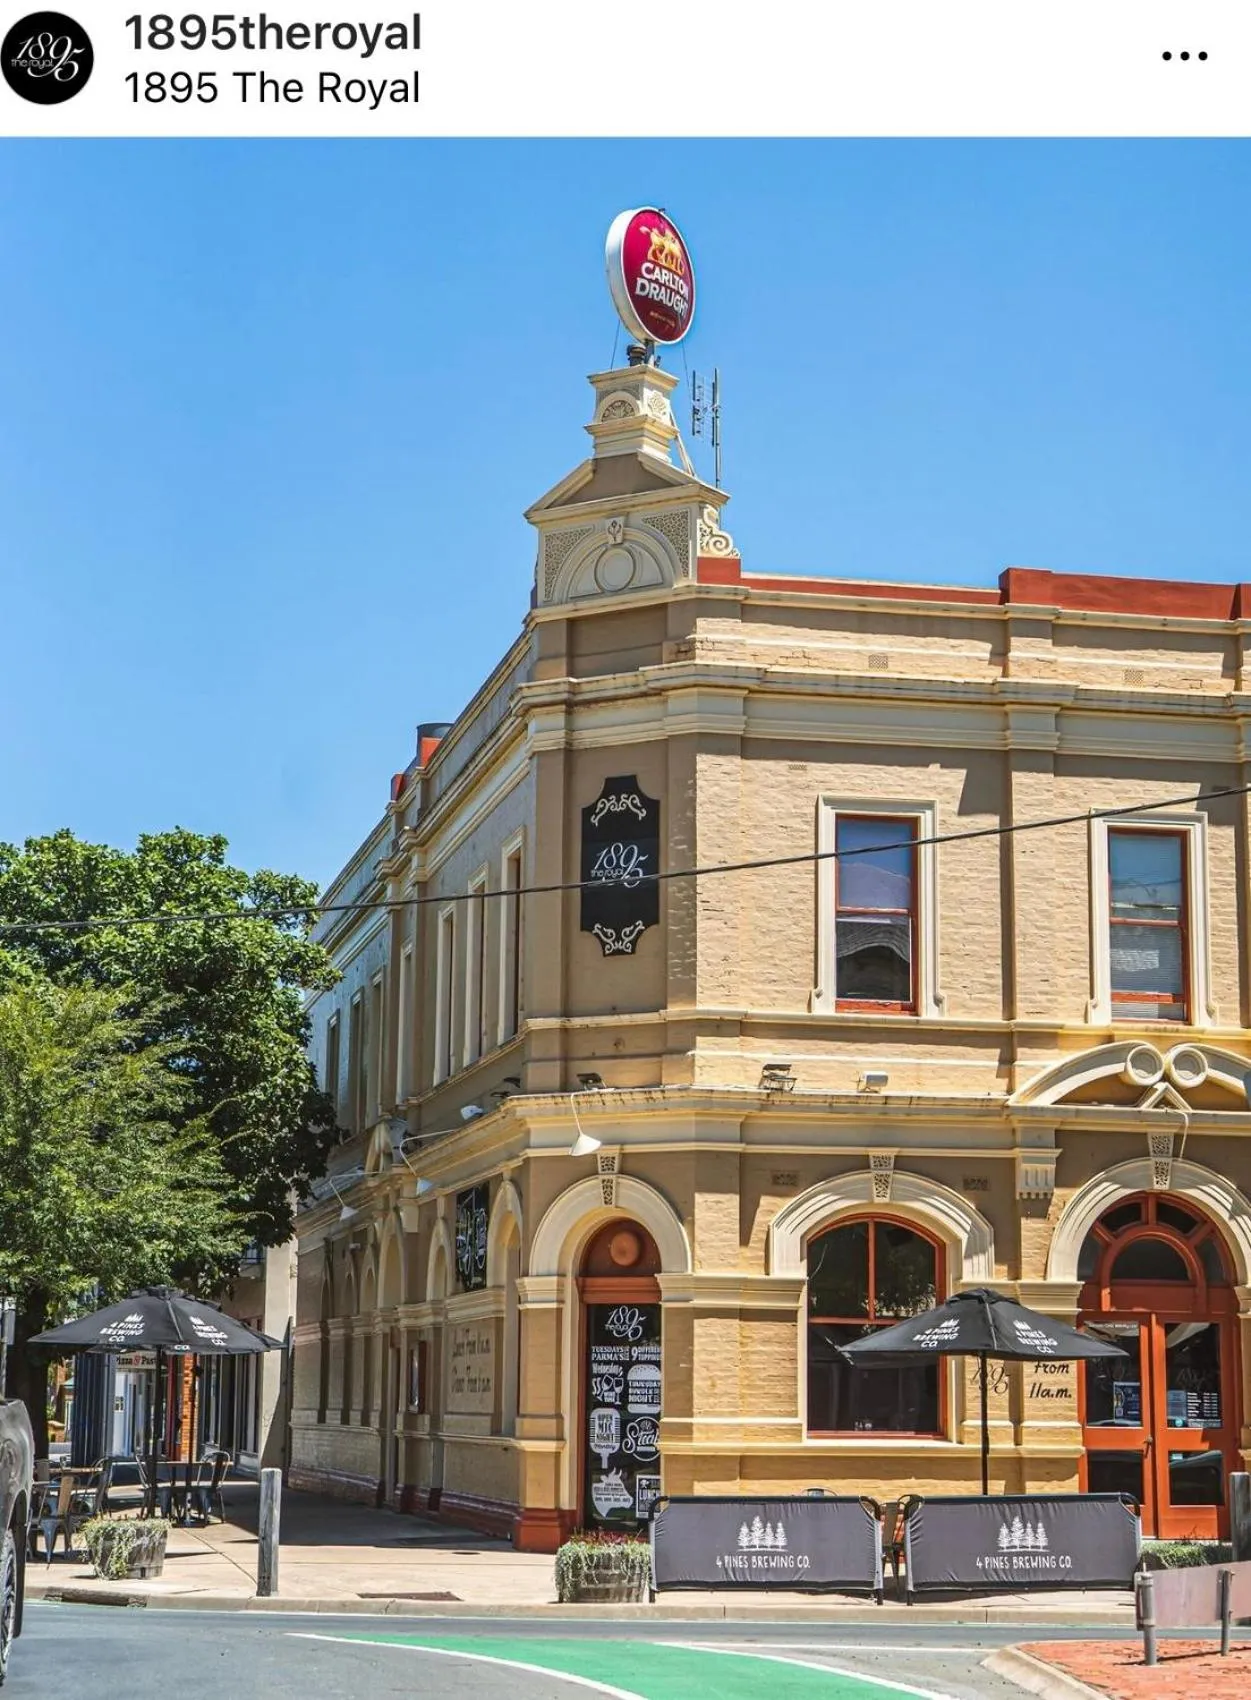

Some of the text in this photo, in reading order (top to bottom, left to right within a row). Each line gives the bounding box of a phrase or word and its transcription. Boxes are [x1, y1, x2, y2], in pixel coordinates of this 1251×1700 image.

[641, 262, 689, 301] CARLTON
[594, 842, 649, 888] 1895
[716, 1555, 811, 1568] 4 PINES BREWING CO.
[976, 1555, 1073, 1569] 4 PINES BREWING CO.
